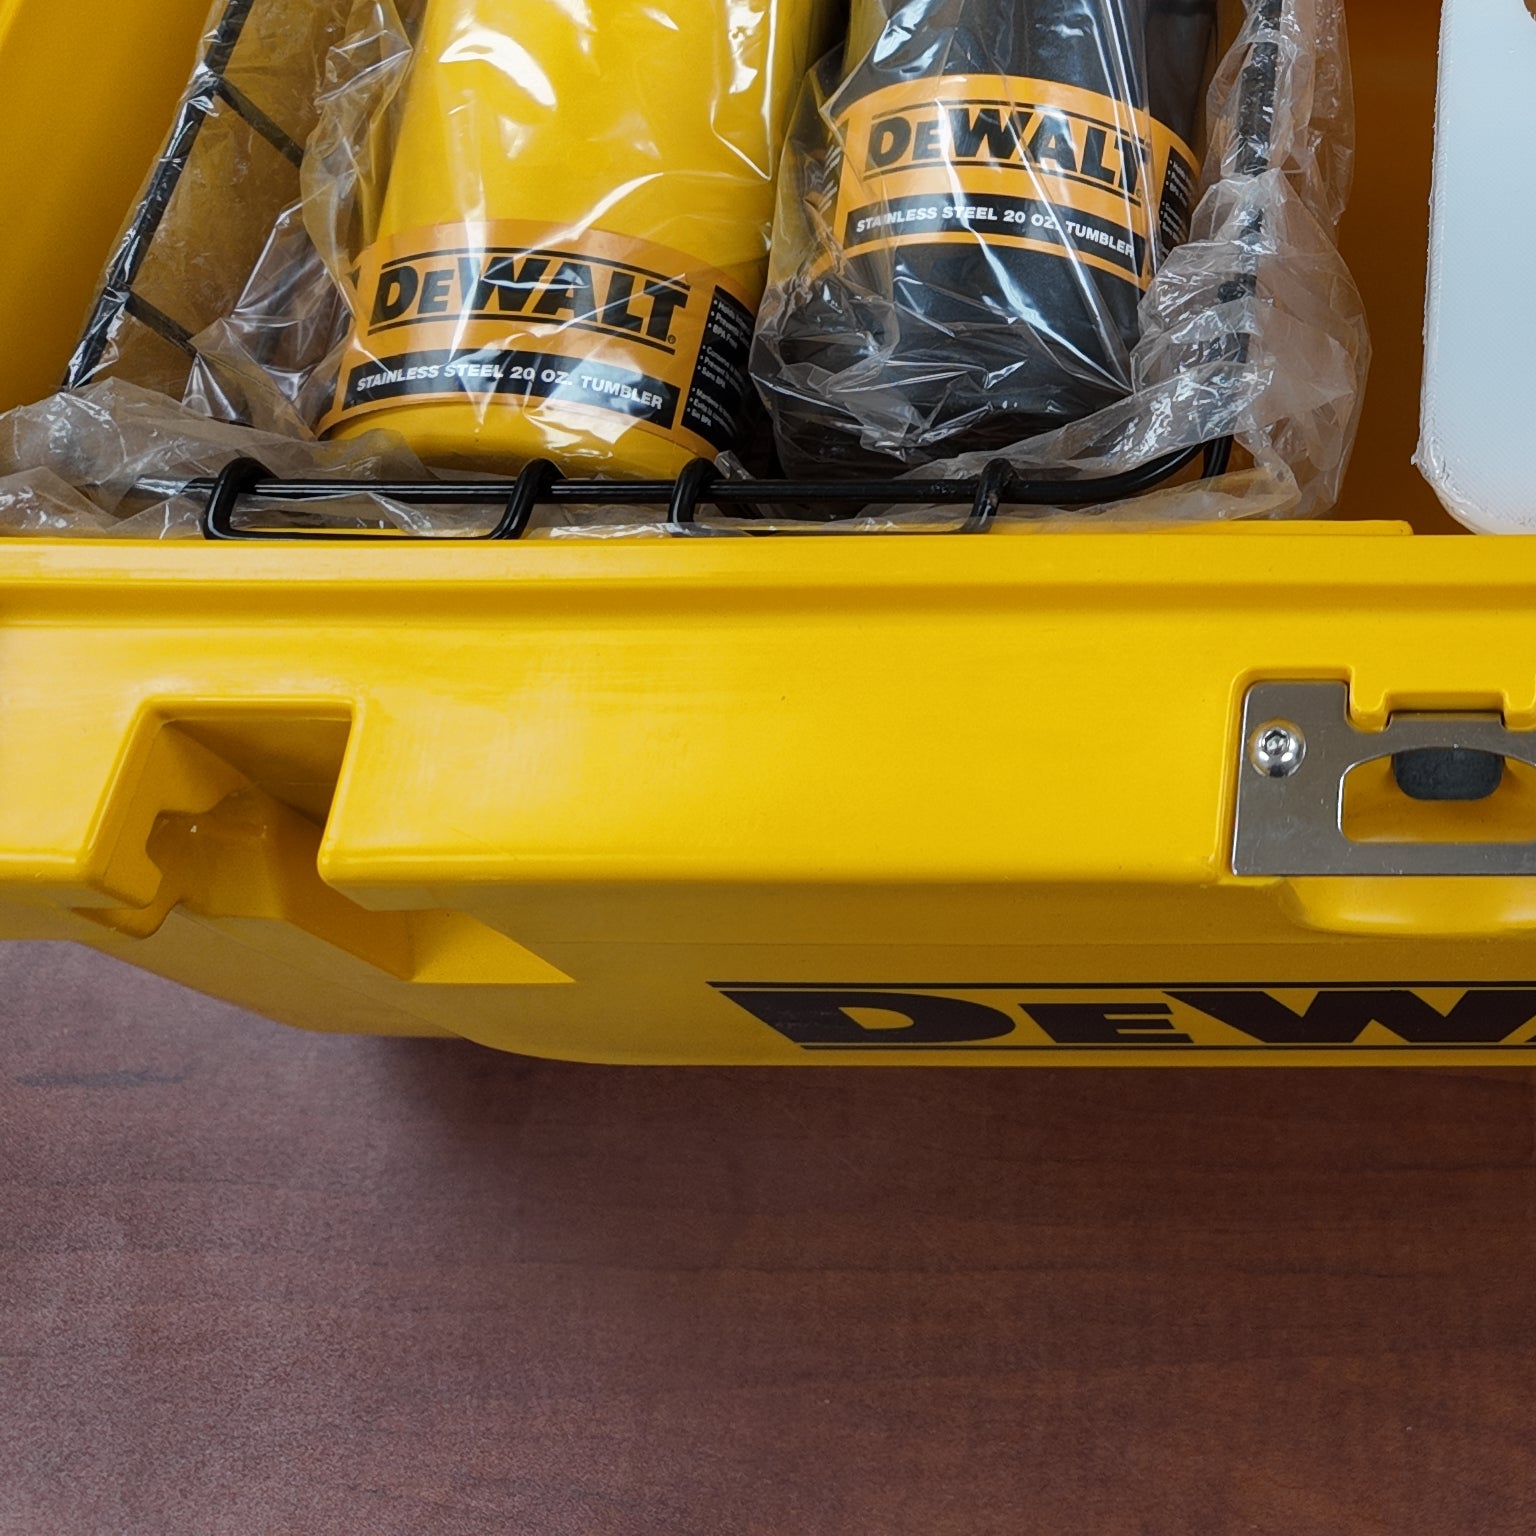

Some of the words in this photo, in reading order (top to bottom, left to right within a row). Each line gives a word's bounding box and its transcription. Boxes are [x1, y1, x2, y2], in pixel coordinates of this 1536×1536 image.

[941, 205, 999, 222] STEEL
[1003, 209, 1027, 225] 20
[1065, 220, 1136, 259] TUMBLER
[356, 363, 440, 392] STAINLESS
[443, 363, 504, 380] STEEL
[509, 365, 536, 382] 20
[540, 368, 573, 387] OZ.
[580, 374, 664, 411] TUMBLER
